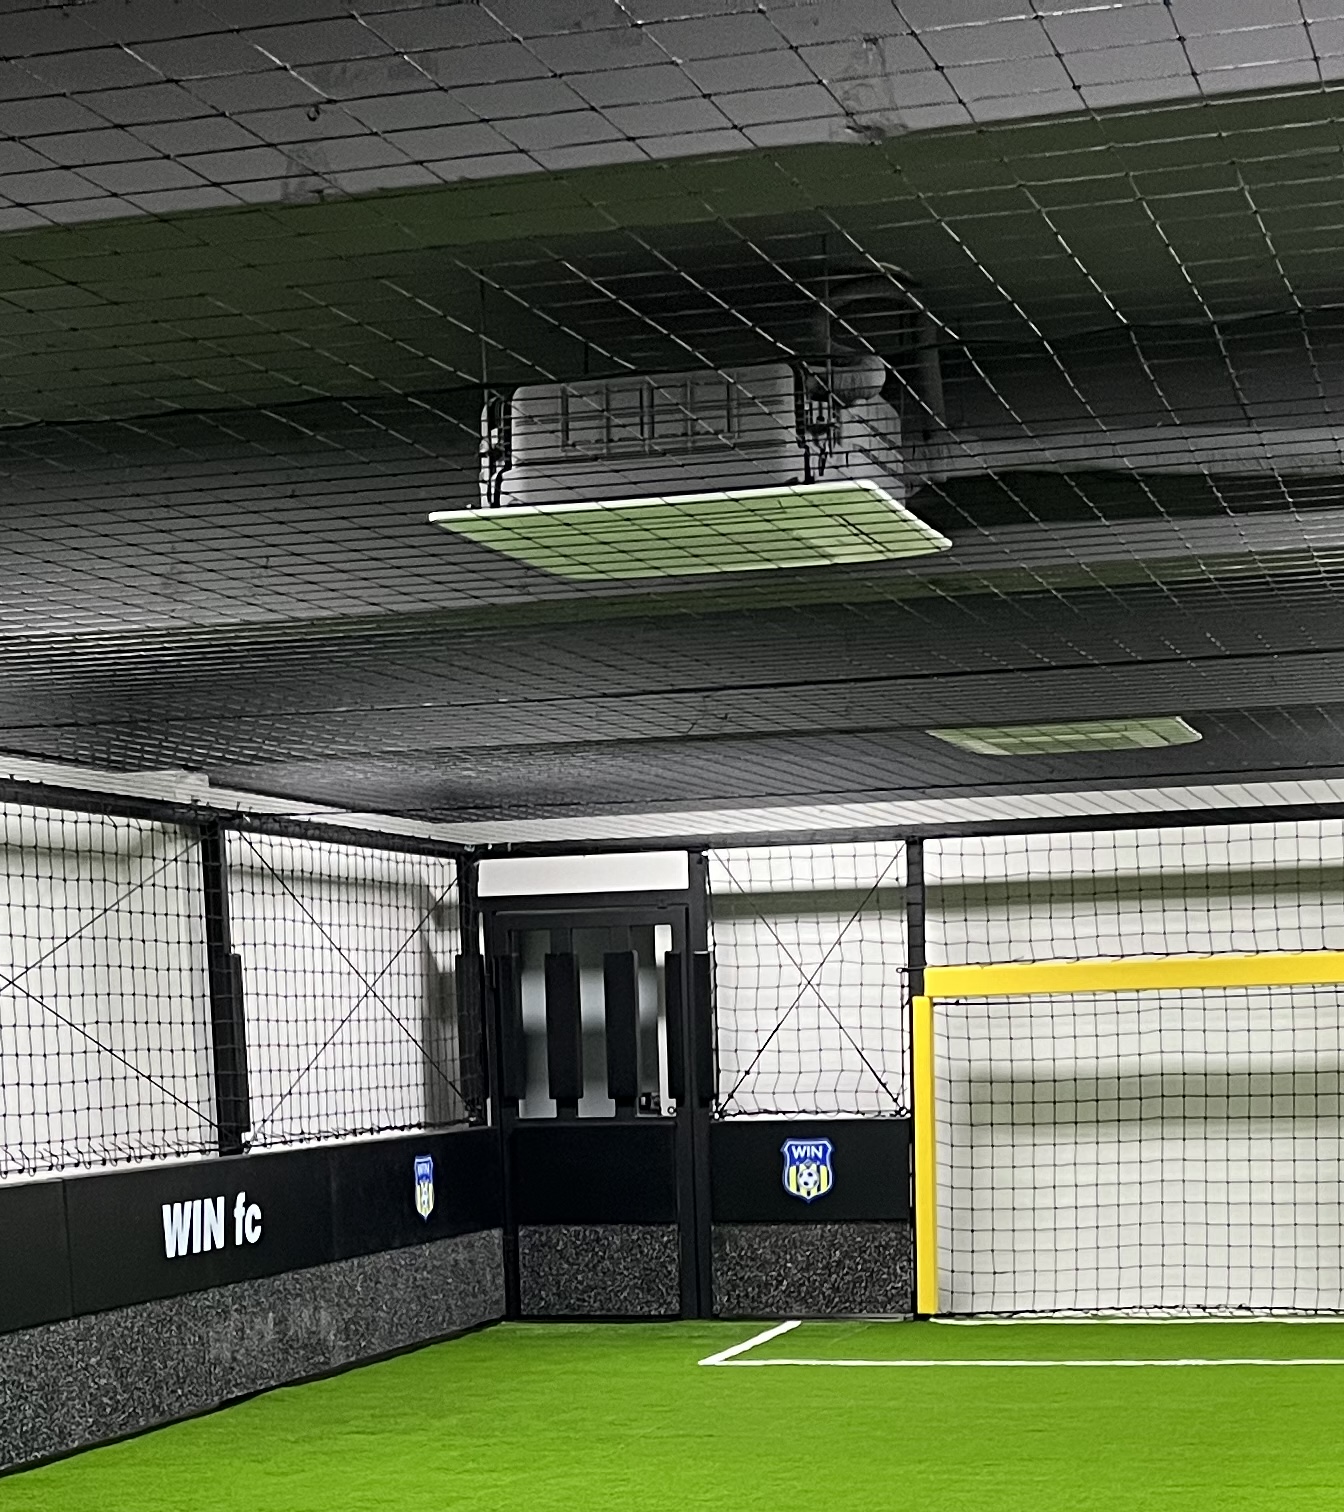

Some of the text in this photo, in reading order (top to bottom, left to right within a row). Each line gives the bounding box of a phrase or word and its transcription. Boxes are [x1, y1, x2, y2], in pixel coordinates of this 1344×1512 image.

[791, 1145, 823, 1159] WIN
[162, 1191, 262, 1258] WIN fc
